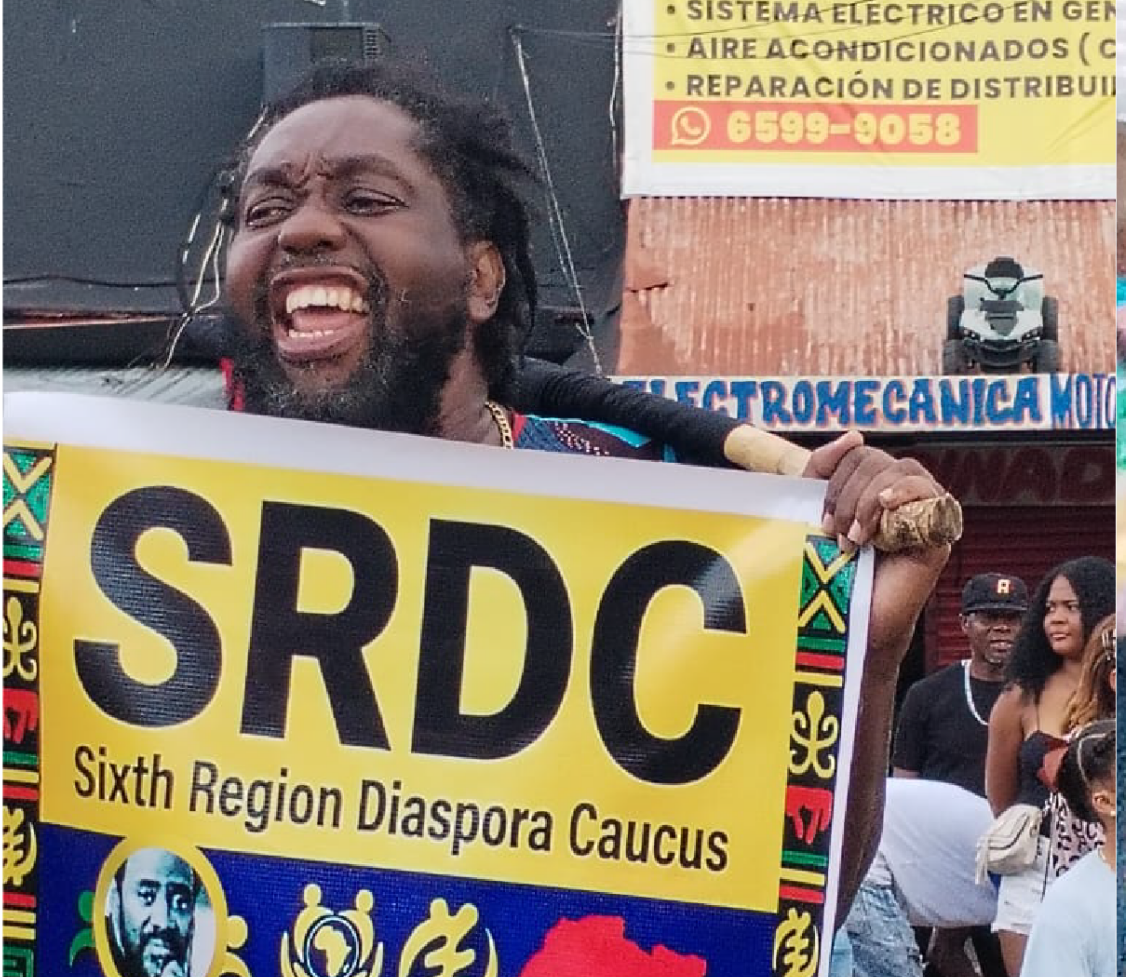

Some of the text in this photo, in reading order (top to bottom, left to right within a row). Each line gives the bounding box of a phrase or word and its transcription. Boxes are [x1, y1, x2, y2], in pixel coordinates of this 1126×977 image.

[687, 0, 823, 23] SISTEMA
[1013, 1, 1051, 22] EN
[687, 37, 757, 59] AIRE
[766, 37, 1069, 62] ACONDICIONADOS
[687, 69, 893, 99] REPARACIÓN
[903, 78, 942, 99] DE
[726, 109, 961, 147] 6599-9058
[622, 376, 1043, 426] ECTROMECANICA
[73, 486, 747, 785] SRDC
[74, 745, 729, 872] Sixth Region Diaspora Caucus
